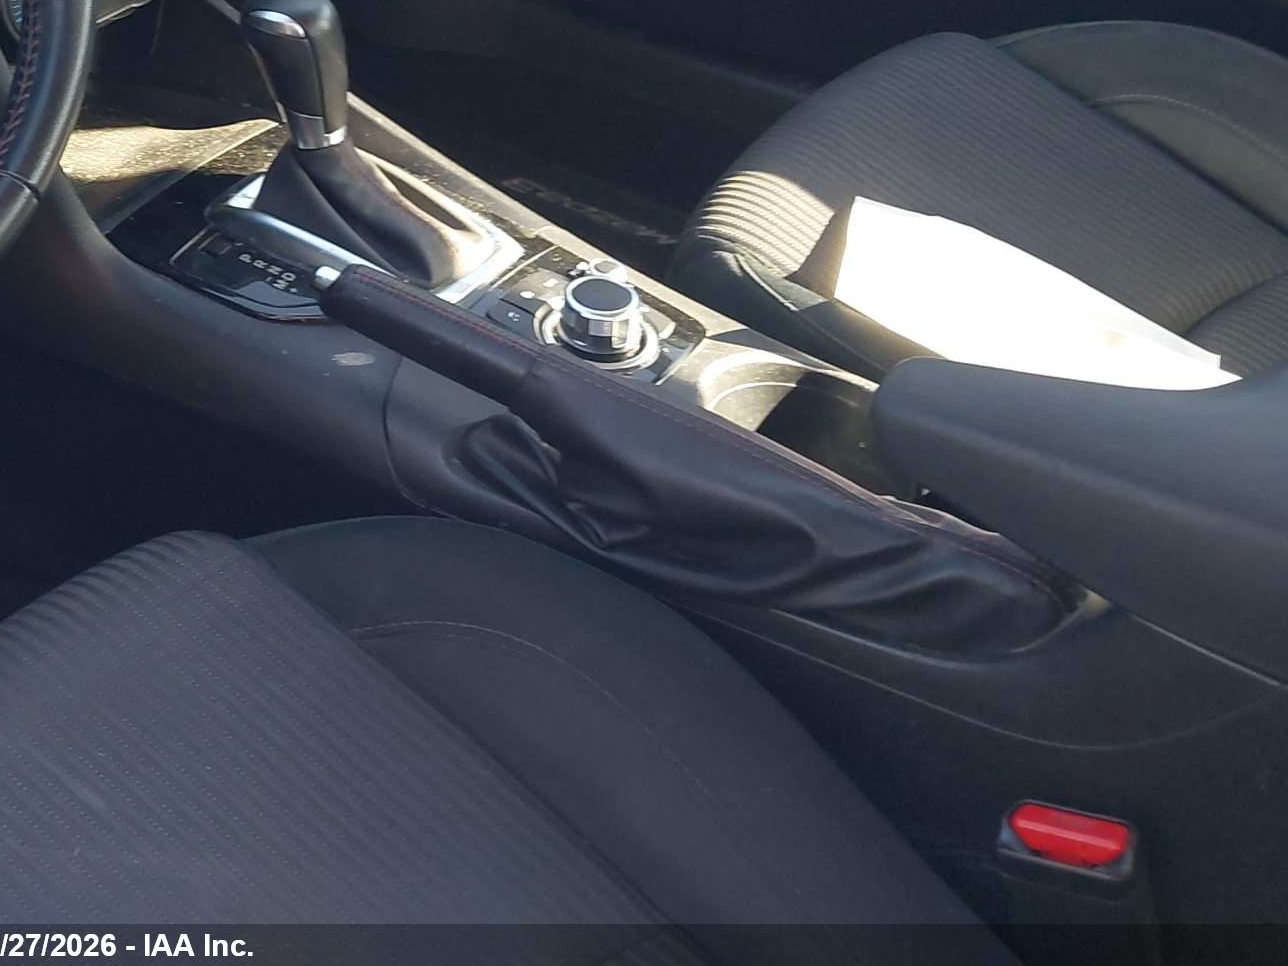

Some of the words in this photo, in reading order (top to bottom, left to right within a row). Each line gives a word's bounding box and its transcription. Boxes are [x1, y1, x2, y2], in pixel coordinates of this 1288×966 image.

[239, 254, 252, 263] P
[253, 260, 268, 268] R
[267, 265, 283, 274] N
[281, 273, 296, 281] D
[273, 279, 289, 289] M
